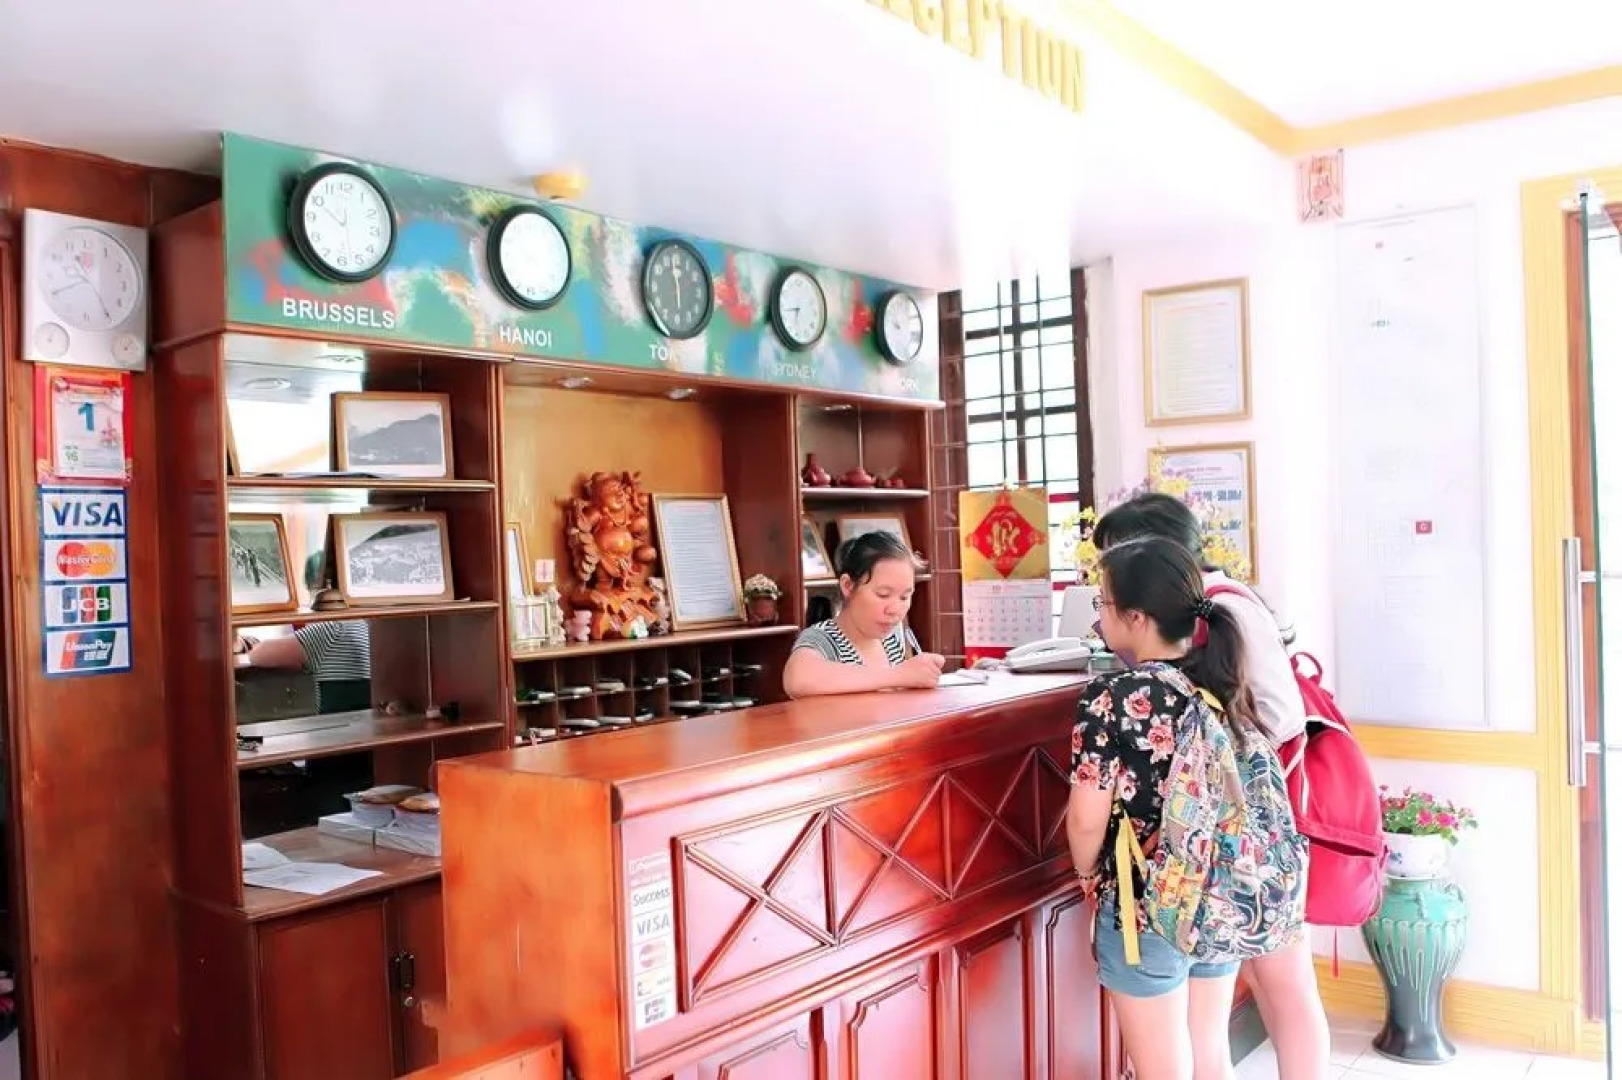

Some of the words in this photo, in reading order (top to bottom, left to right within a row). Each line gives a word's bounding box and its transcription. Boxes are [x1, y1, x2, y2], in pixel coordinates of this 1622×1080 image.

[283, 297, 396, 329] BRUSSELS
[500, 325, 552, 348] HANOI
[78, 402, 95, 431] 1
[52, 502, 123, 527] VISA
[61, 597, 110, 611] JCB
[633, 886, 671, 908] Success
[637, 912, 671, 937] VISA
